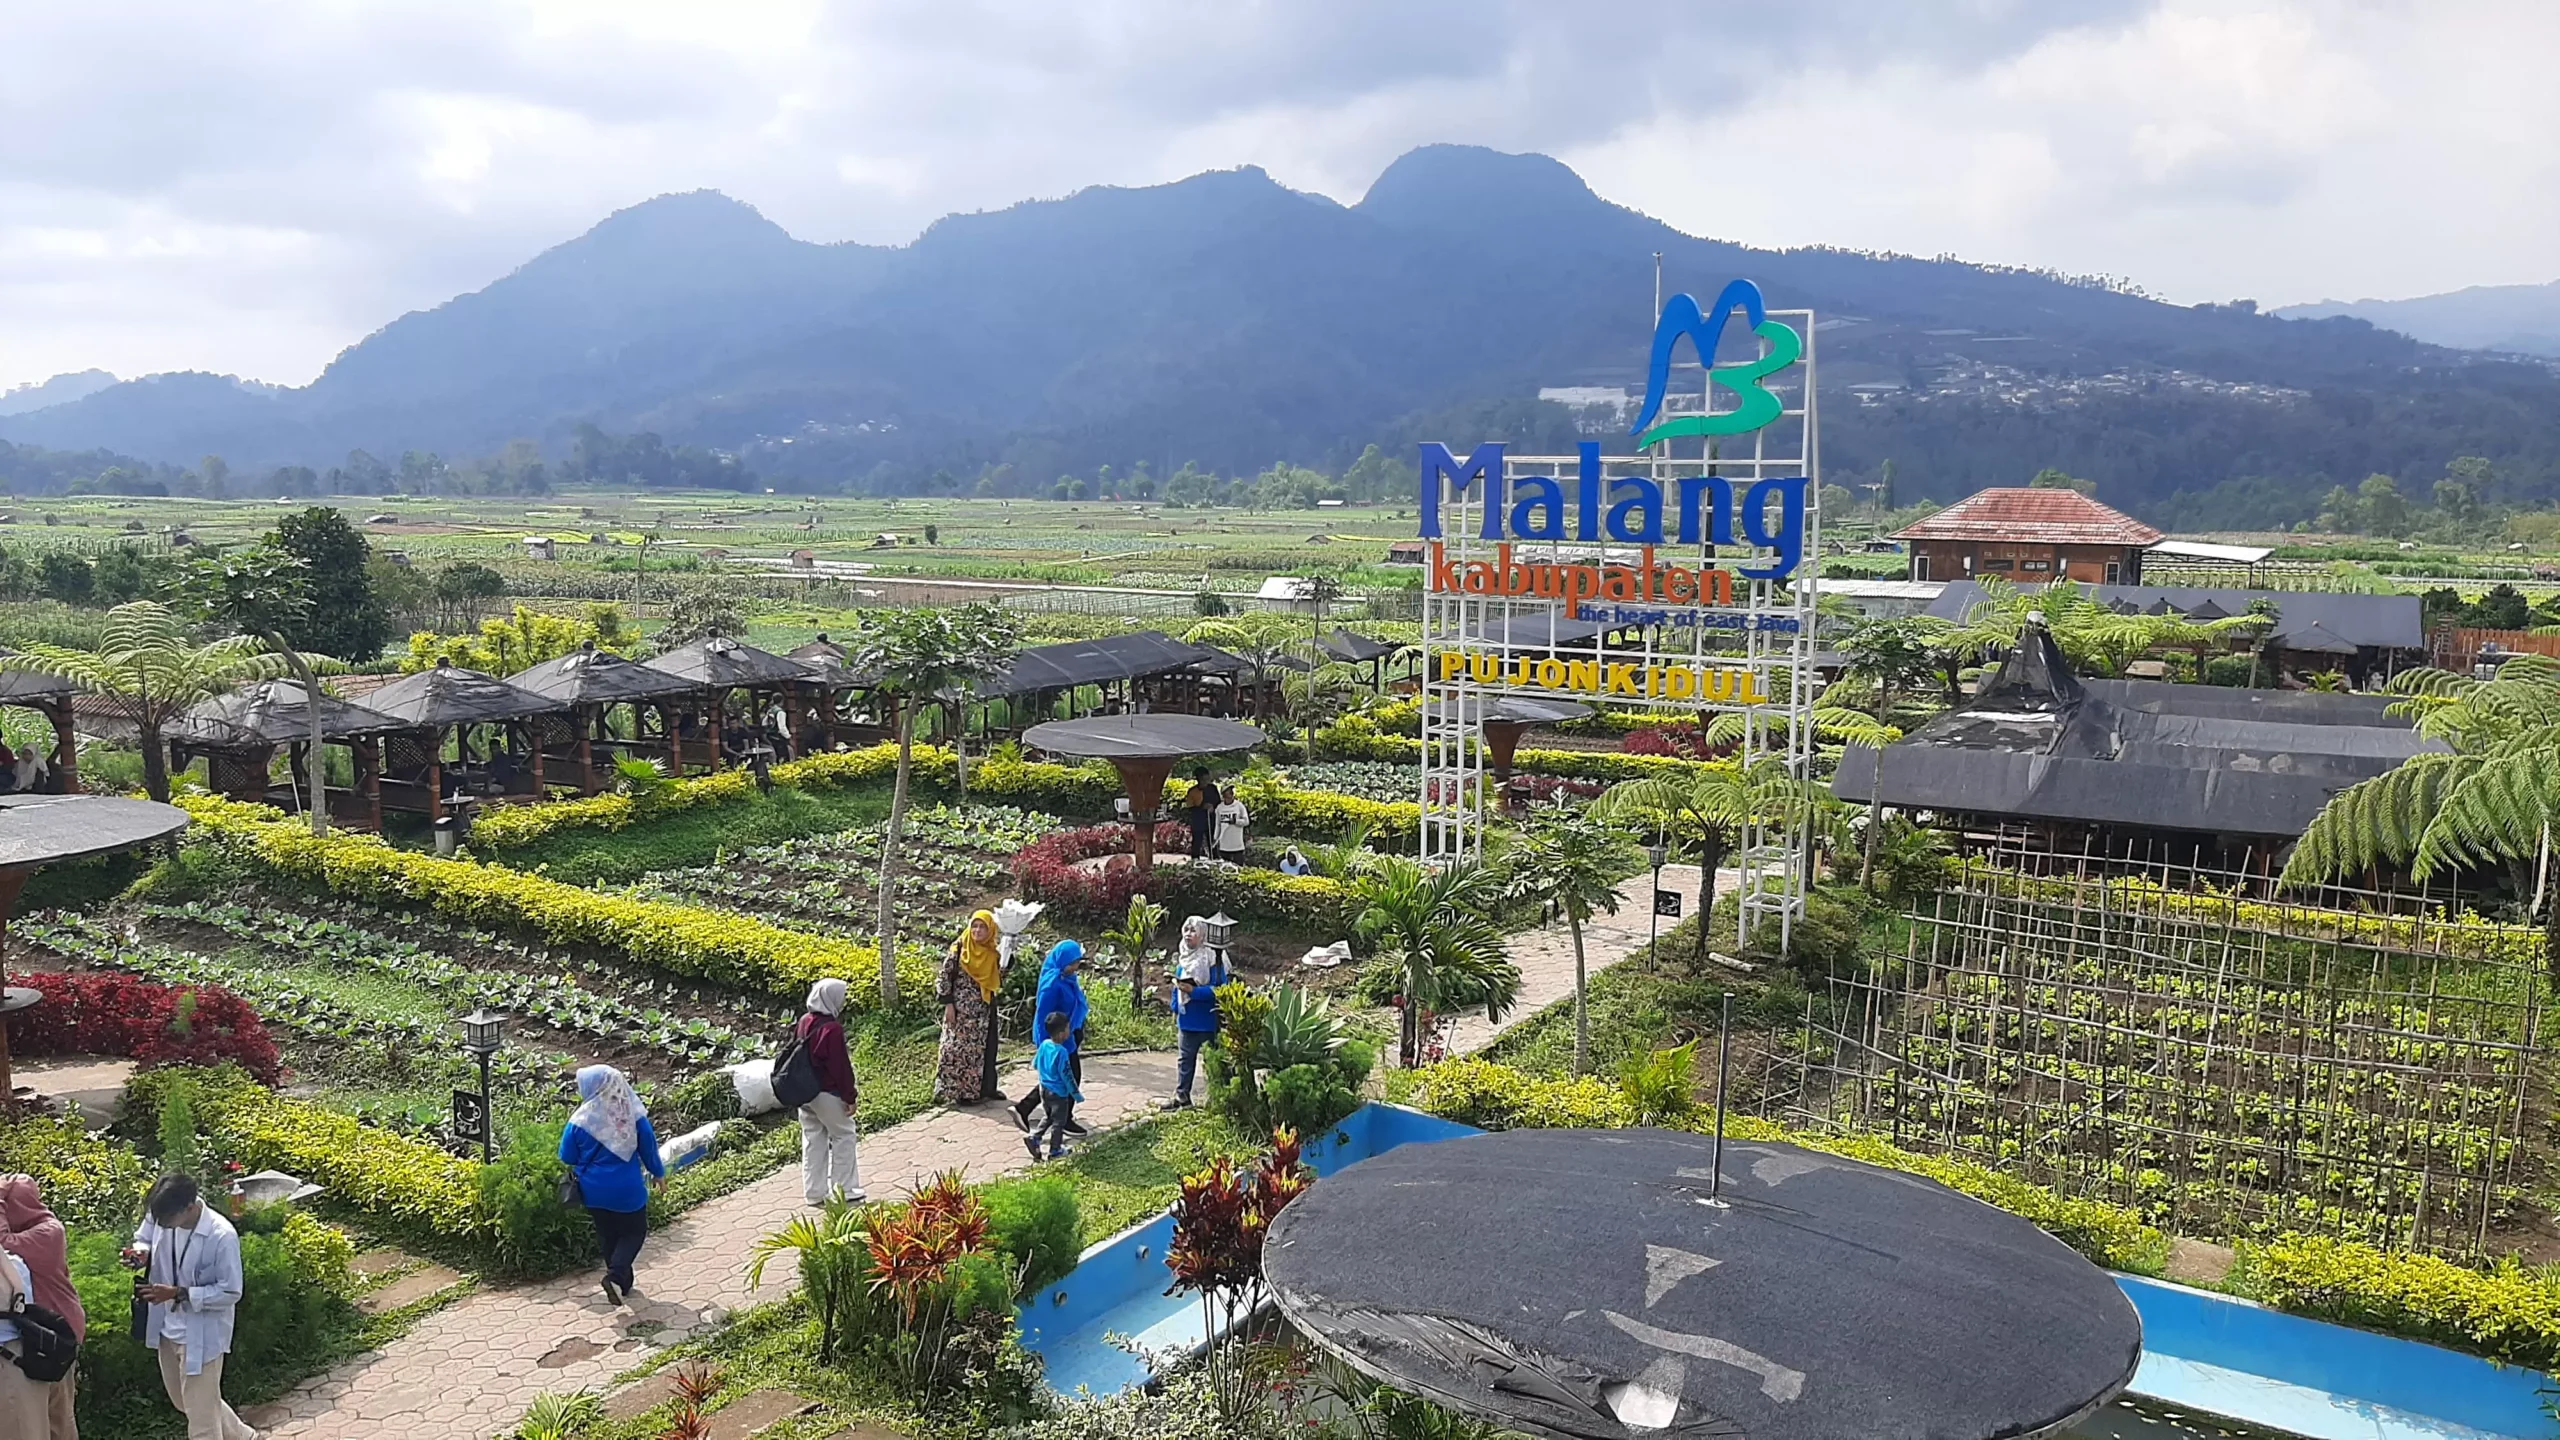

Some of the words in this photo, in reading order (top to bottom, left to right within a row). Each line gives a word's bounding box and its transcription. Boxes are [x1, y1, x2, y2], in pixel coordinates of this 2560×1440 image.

[1419, 441, 1811, 579] Malang
[1429, 542, 1732, 619] kabupaten
[1577, 605, 1609, 622] the
[1614, 606, 1667, 625] heart
[1673, 609, 1699, 627] of
[1703, 614, 1749, 630] east
